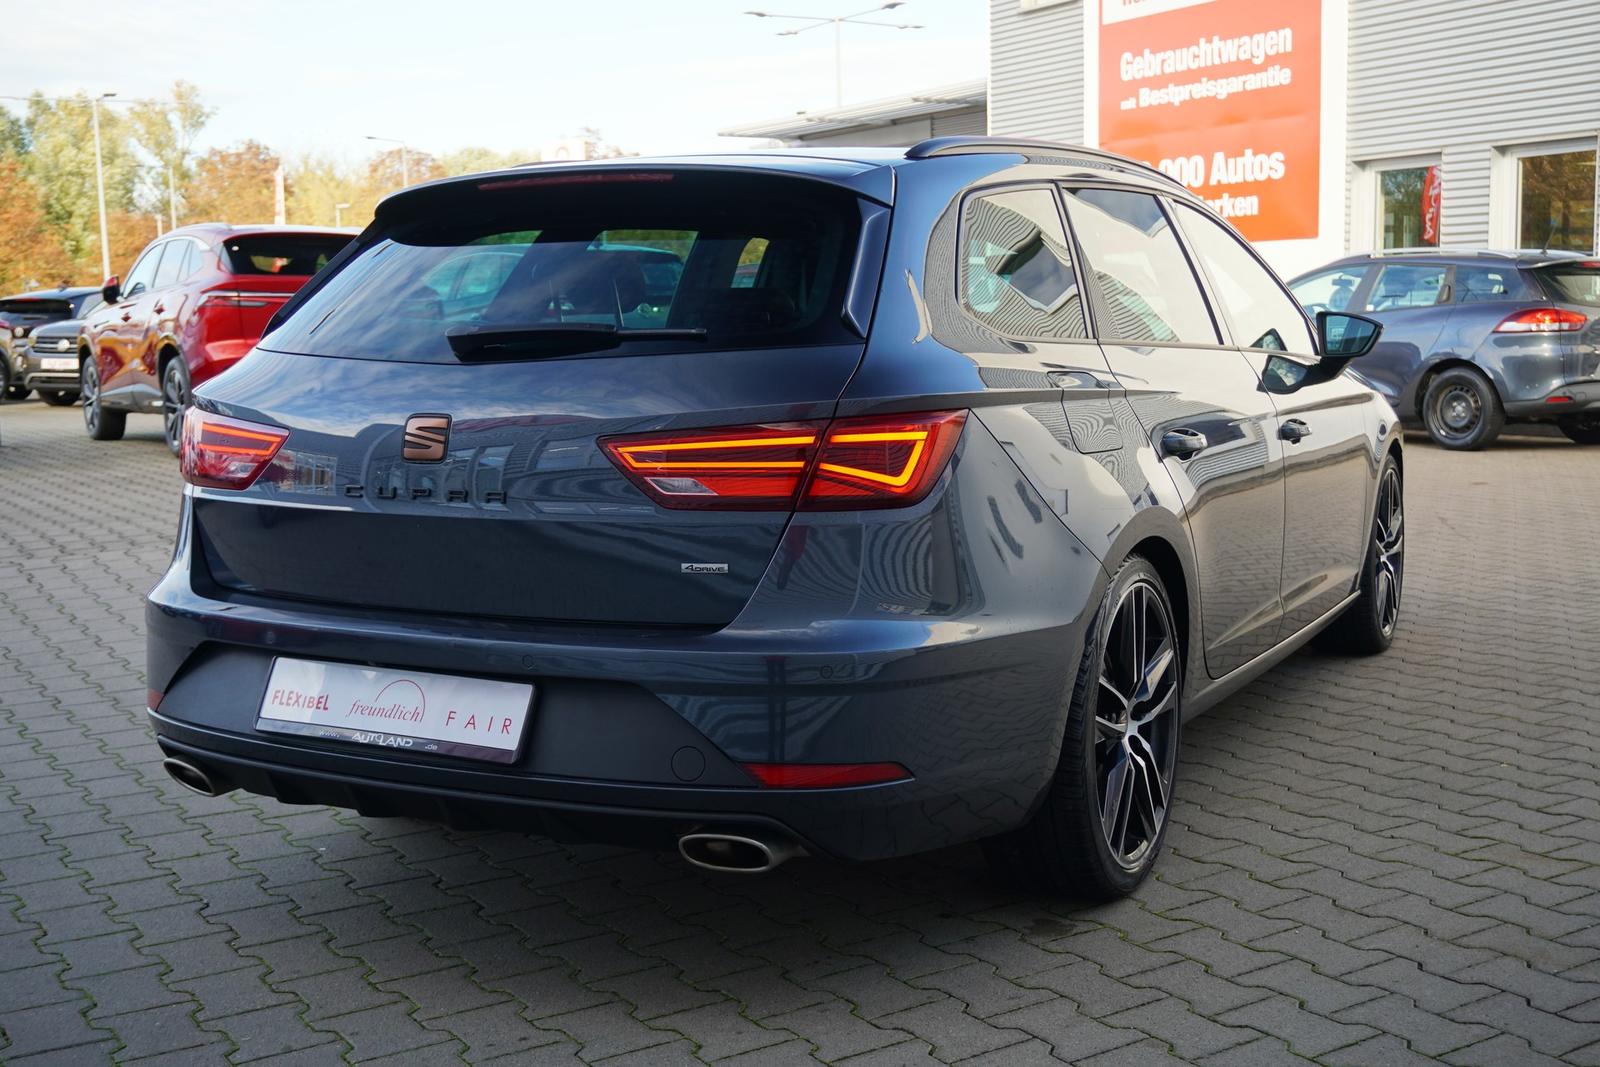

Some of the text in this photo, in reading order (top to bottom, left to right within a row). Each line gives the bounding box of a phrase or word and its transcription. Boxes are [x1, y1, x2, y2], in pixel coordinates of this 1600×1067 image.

[1120, 27, 1292, 81] Gebrauchtwagen
[1139, 65, 1291, 107] Bestpreisgarantie
[1209, 149, 1285, 185] Autos
[271, 689, 512, 735] FLEXIBEL freundlich FAIR
